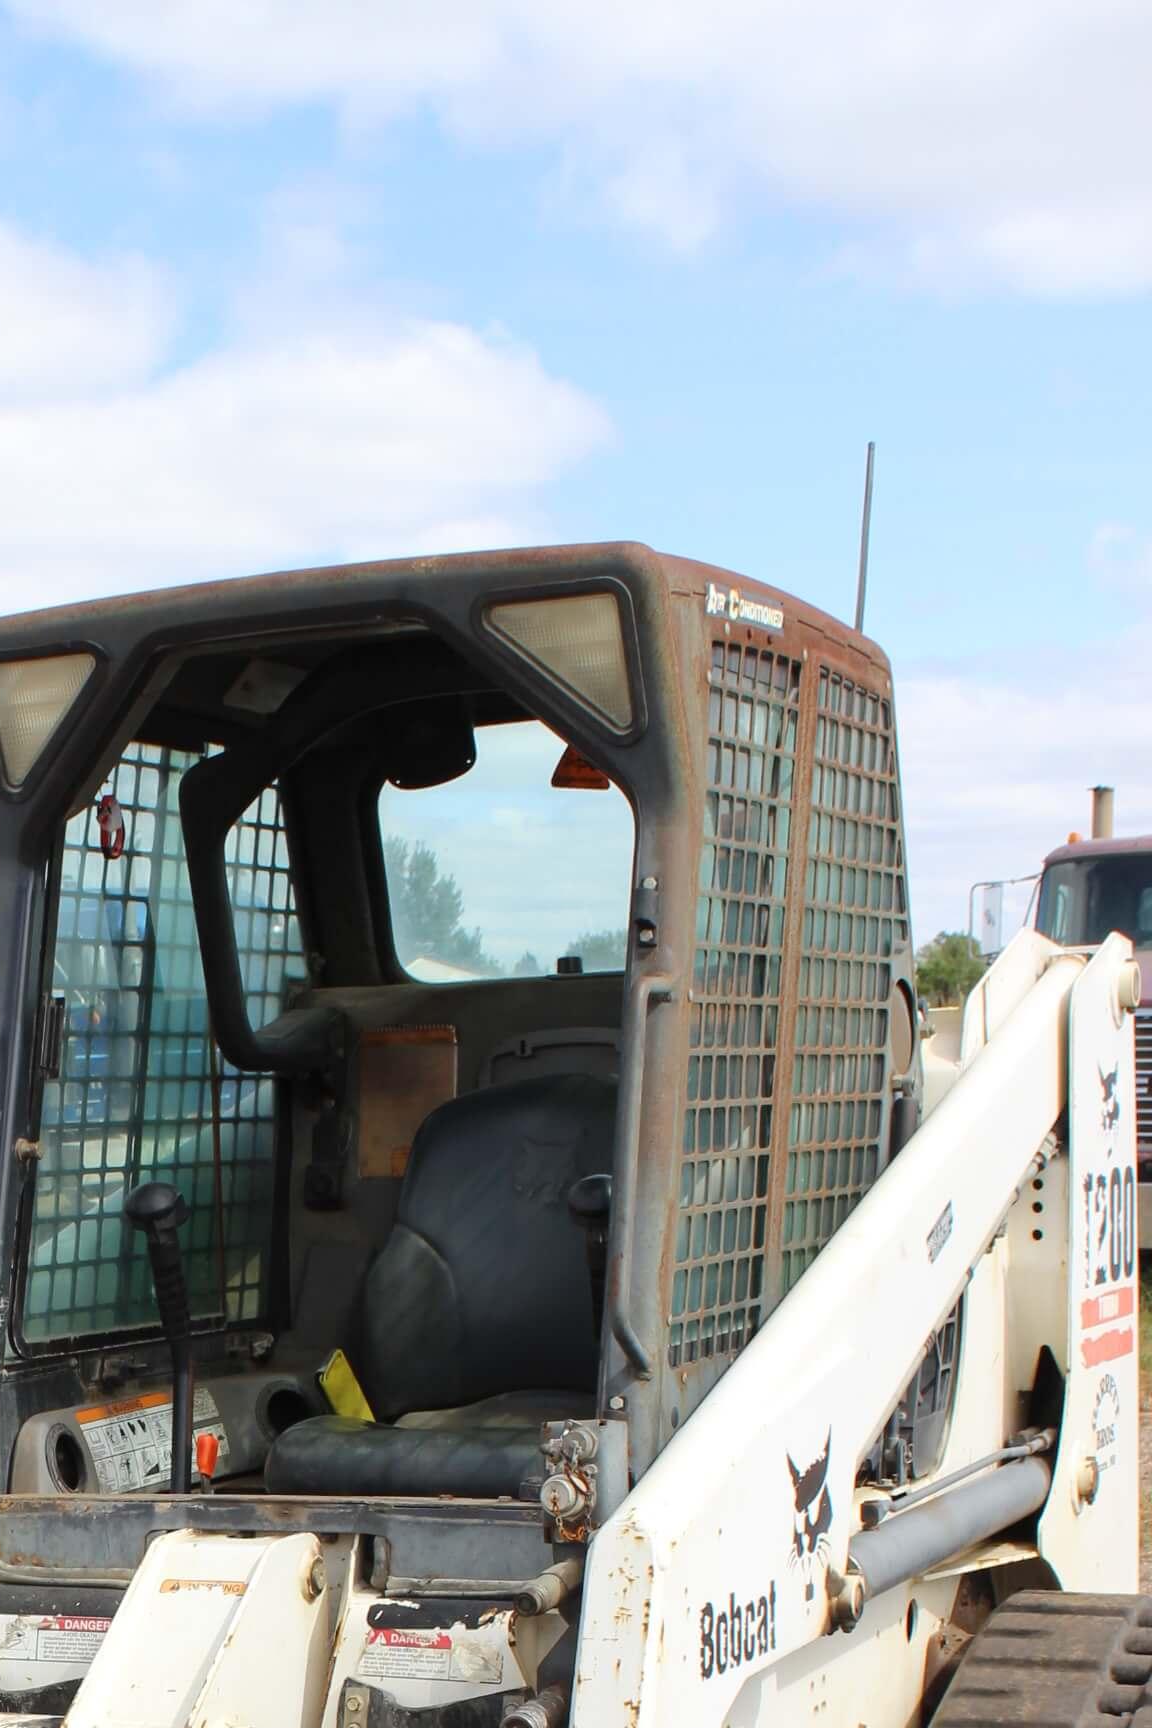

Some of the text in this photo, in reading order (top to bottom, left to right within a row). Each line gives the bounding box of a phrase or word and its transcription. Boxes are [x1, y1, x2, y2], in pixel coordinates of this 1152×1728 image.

[64, 1619, 110, 1631] DANGER
[700, 1579, 776, 1681] Bobcat
[390, 1632, 441, 1646] DANR
